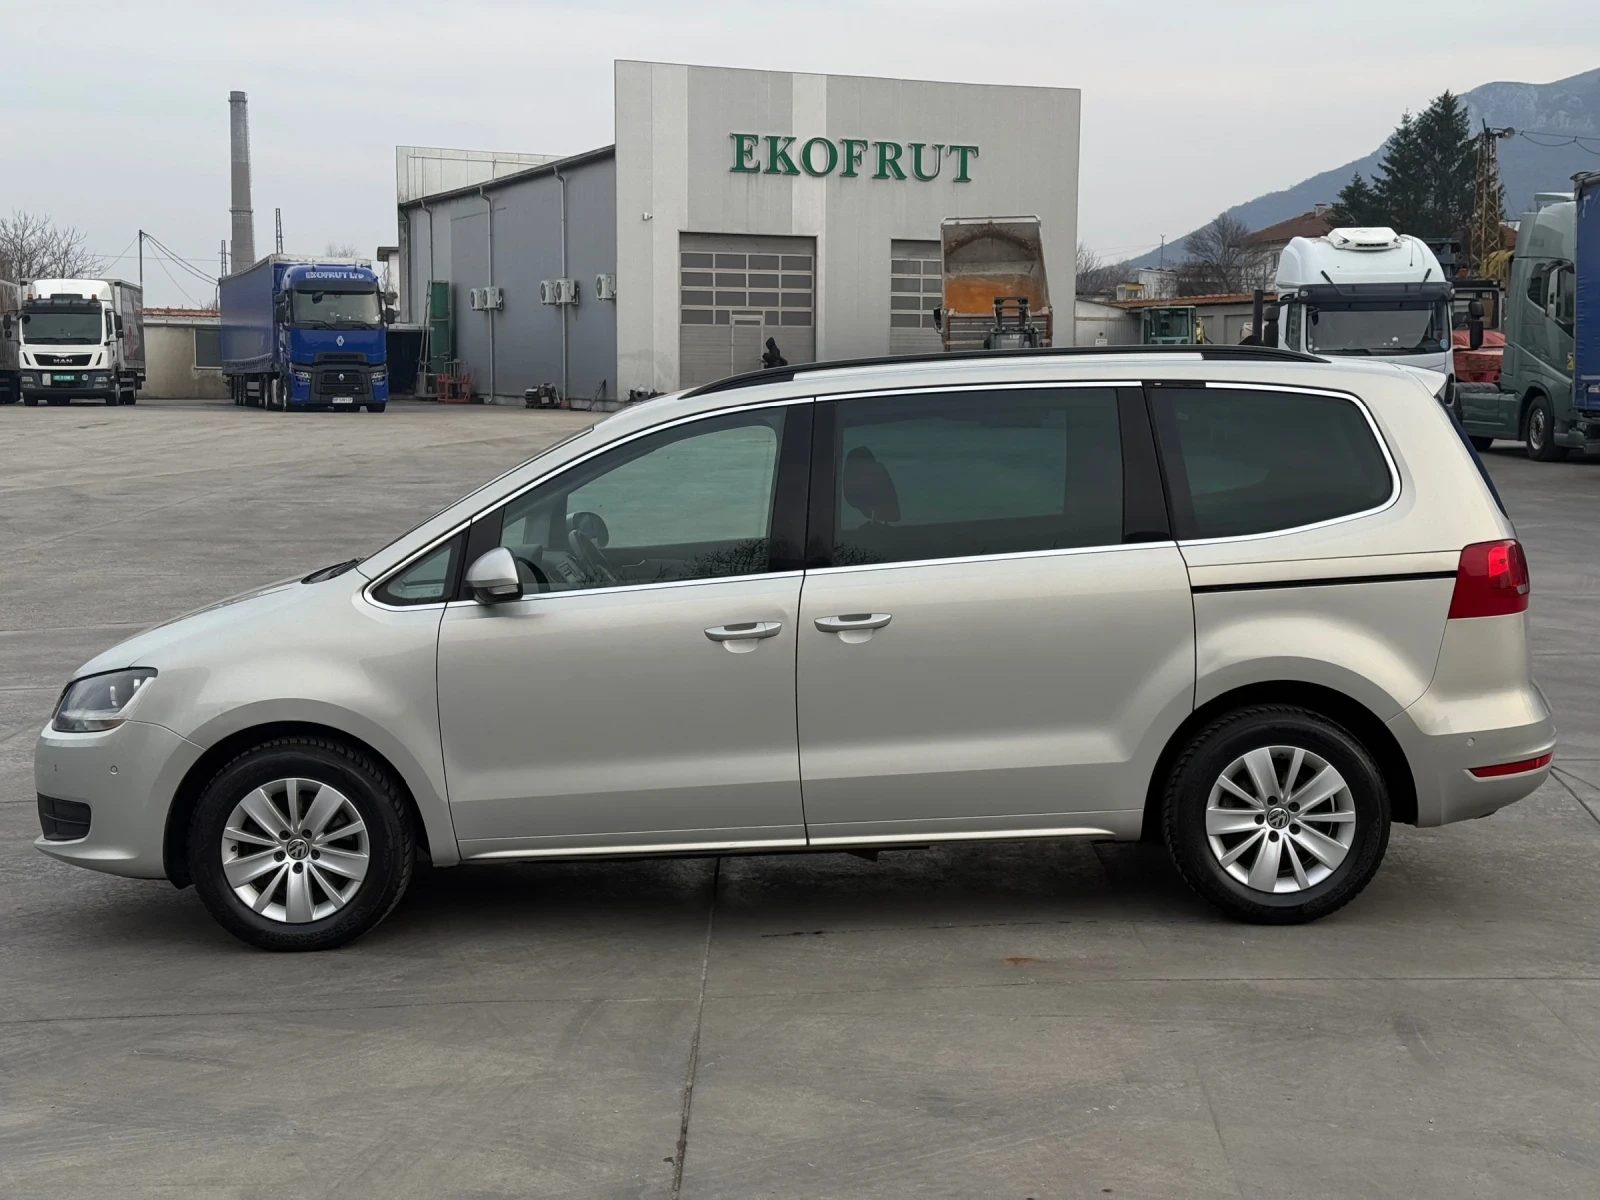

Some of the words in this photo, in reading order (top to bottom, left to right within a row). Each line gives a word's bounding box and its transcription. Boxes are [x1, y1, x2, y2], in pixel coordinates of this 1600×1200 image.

[730, 132, 979, 183] EKOFRUT
[305, 271, 348, 279] EKOFRUT
[349, 271, 364, 279] LTD
